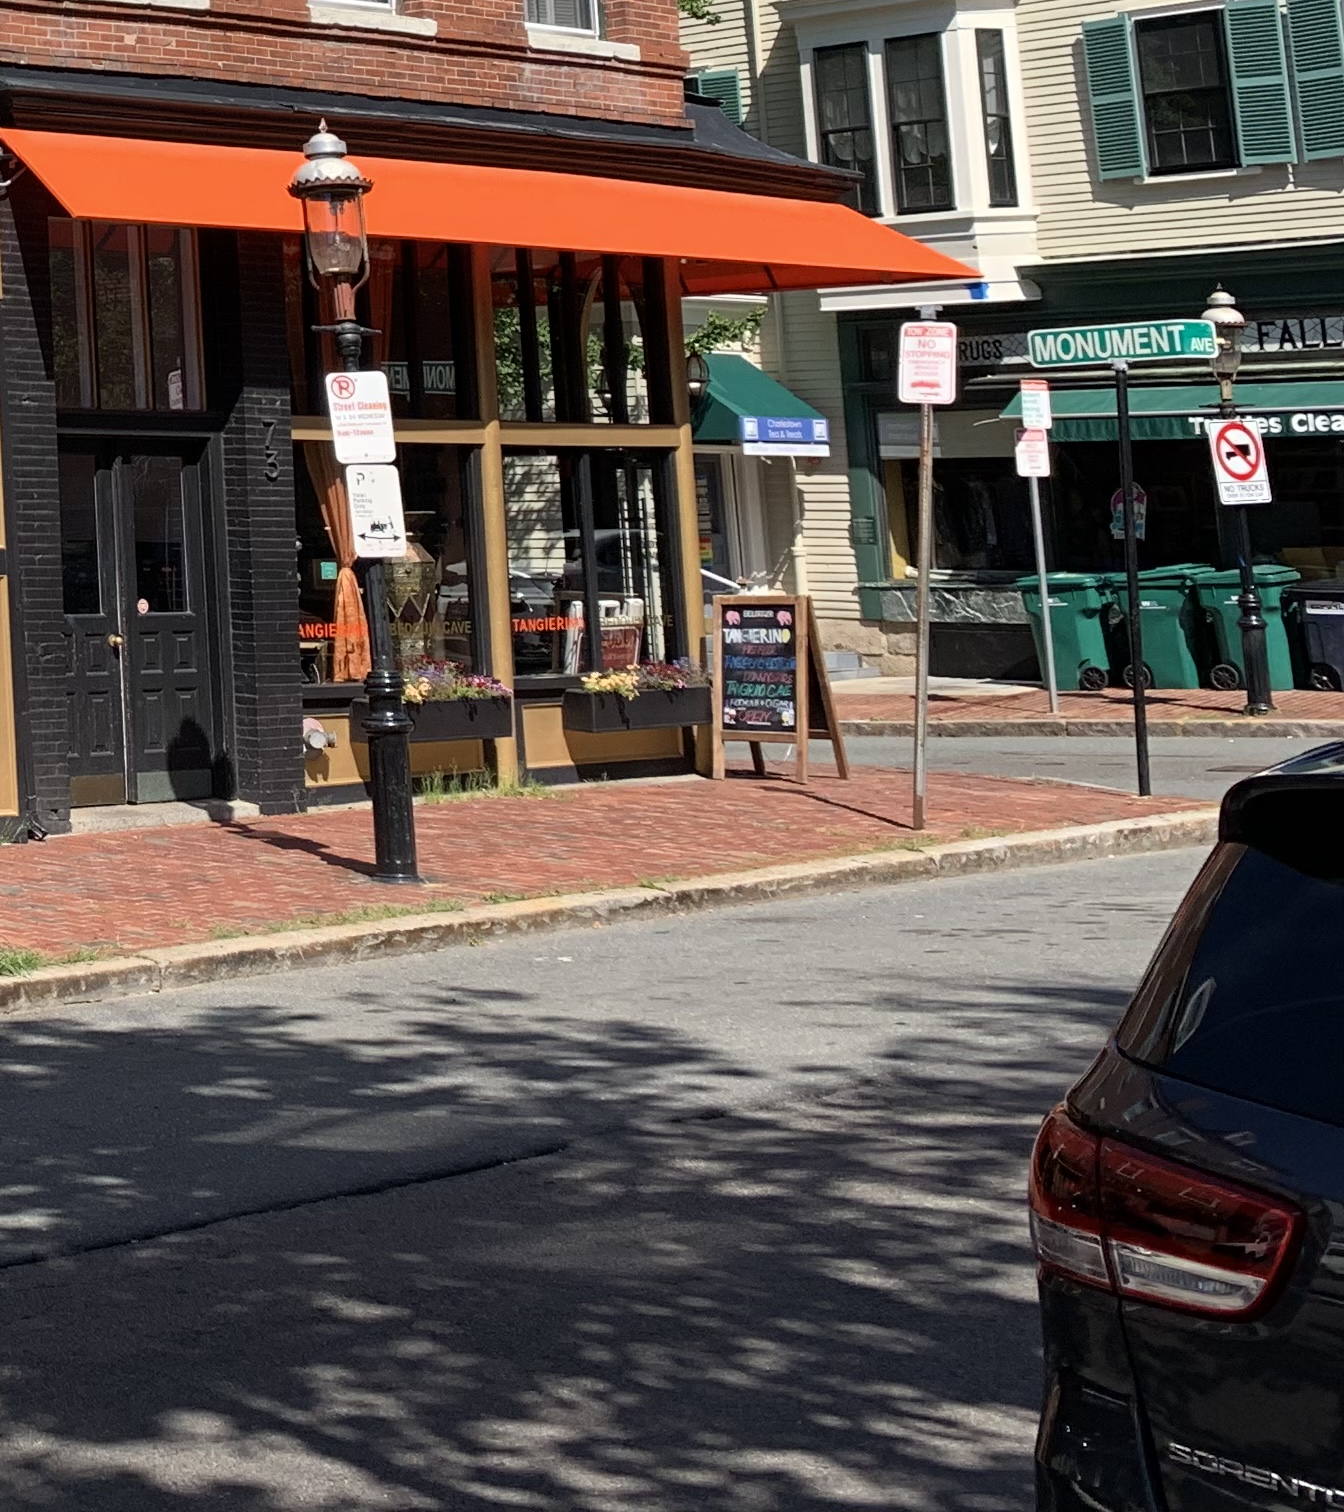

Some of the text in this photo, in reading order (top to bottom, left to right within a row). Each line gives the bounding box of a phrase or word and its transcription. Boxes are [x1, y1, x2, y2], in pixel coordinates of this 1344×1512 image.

[1034, 324, 1213, 362] MONUMENT AVE
[1256, 319, 1344, 351] FALL
[918, 339, 937, 349] NO
[1291, 413, 1344, 433] Clea
[1224, 483, 1264, 493] NO TRUCKS
[443, 620, 472, 635] CAVE
